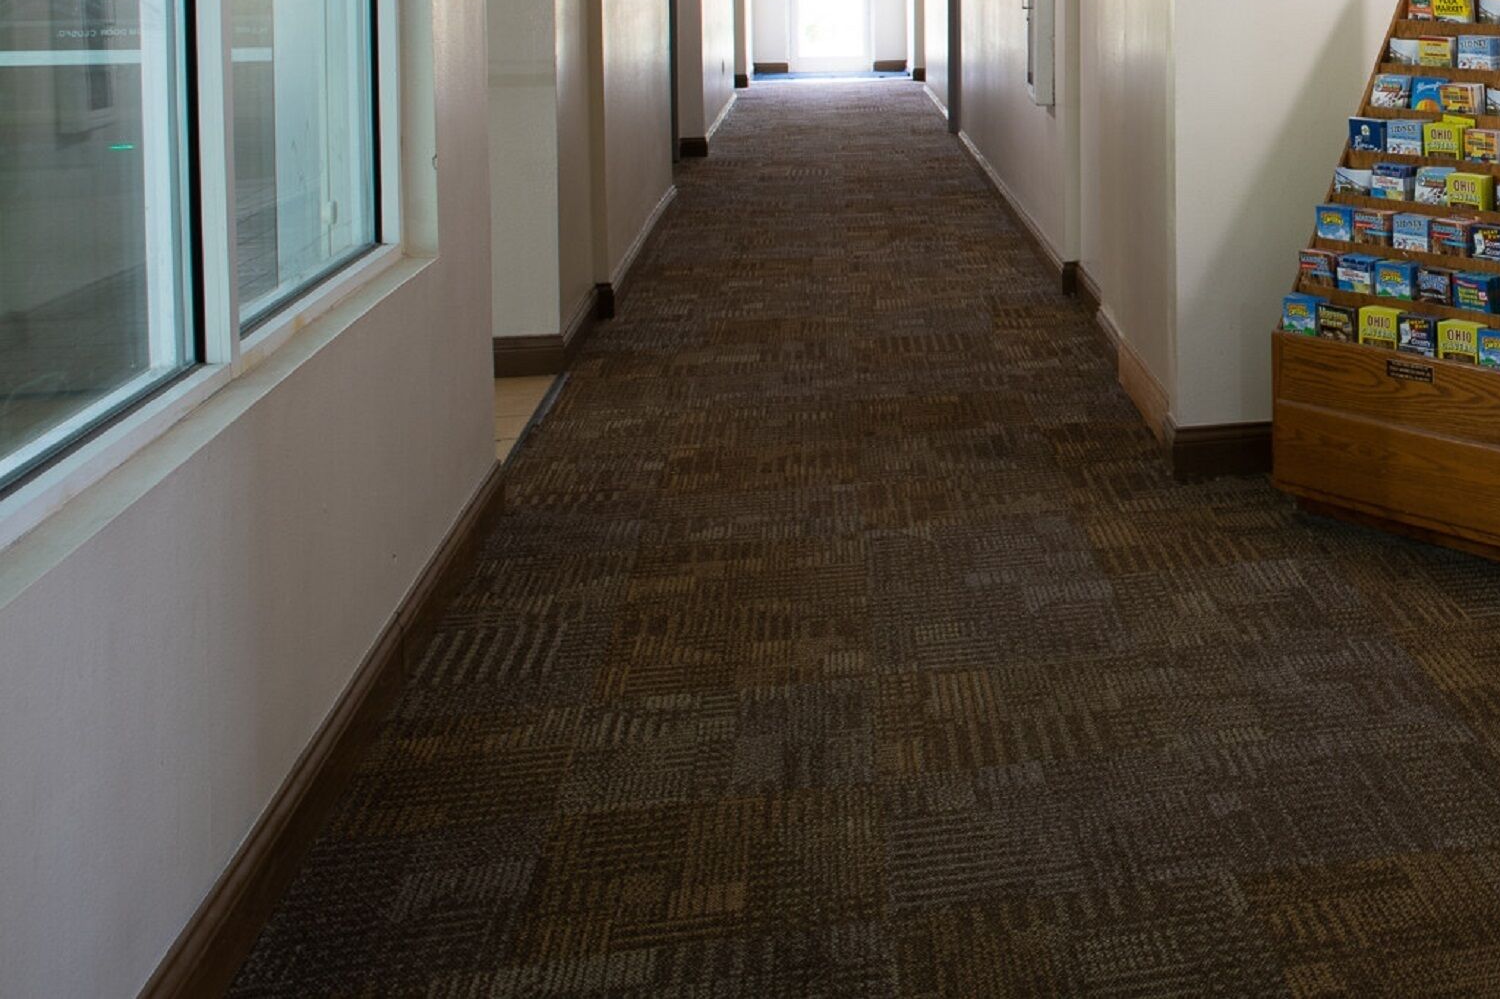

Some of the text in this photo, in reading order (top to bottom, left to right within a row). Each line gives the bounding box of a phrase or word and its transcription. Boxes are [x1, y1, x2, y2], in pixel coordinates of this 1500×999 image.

[1436, 4, 1463, 13] MARKET
[1431, 129, 1453, 140] OHIO
[1453, 180, 1476, 192] OHIO
[1367, 315, 1391, 329] OHIO
[1447, 328, 1472, 343] OHIO
